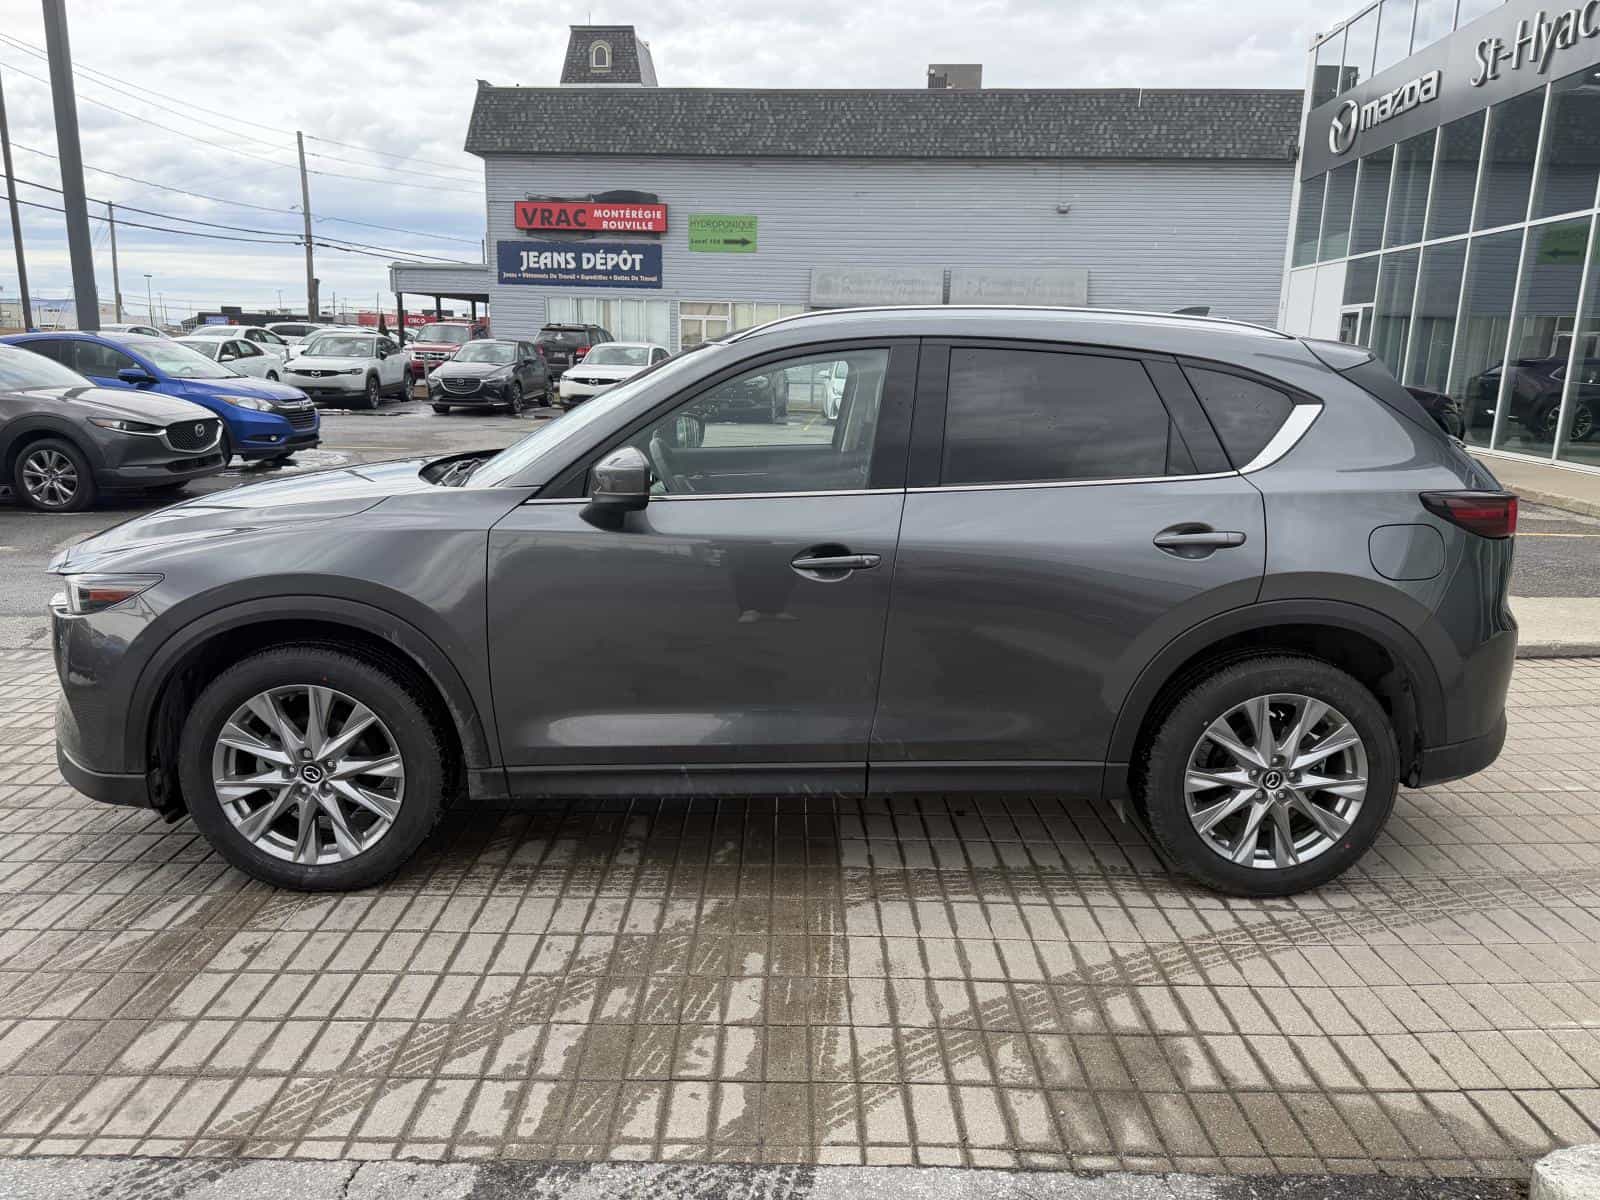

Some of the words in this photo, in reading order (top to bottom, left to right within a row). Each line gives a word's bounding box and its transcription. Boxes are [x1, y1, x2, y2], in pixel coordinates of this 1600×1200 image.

[1359, 69, 1442, 132] mazda
[521, 207, 587, 227] VRAC
[593, 207, 662, 219] MONTÉRÉGIE
[602, 220, 654, 231] ROUVILLE
[690, 217, 754, 229] HYDROPONIQUE
[519, 250, 577, 271] JEANS
[582, 249, 644, 271] DÉPÔT
